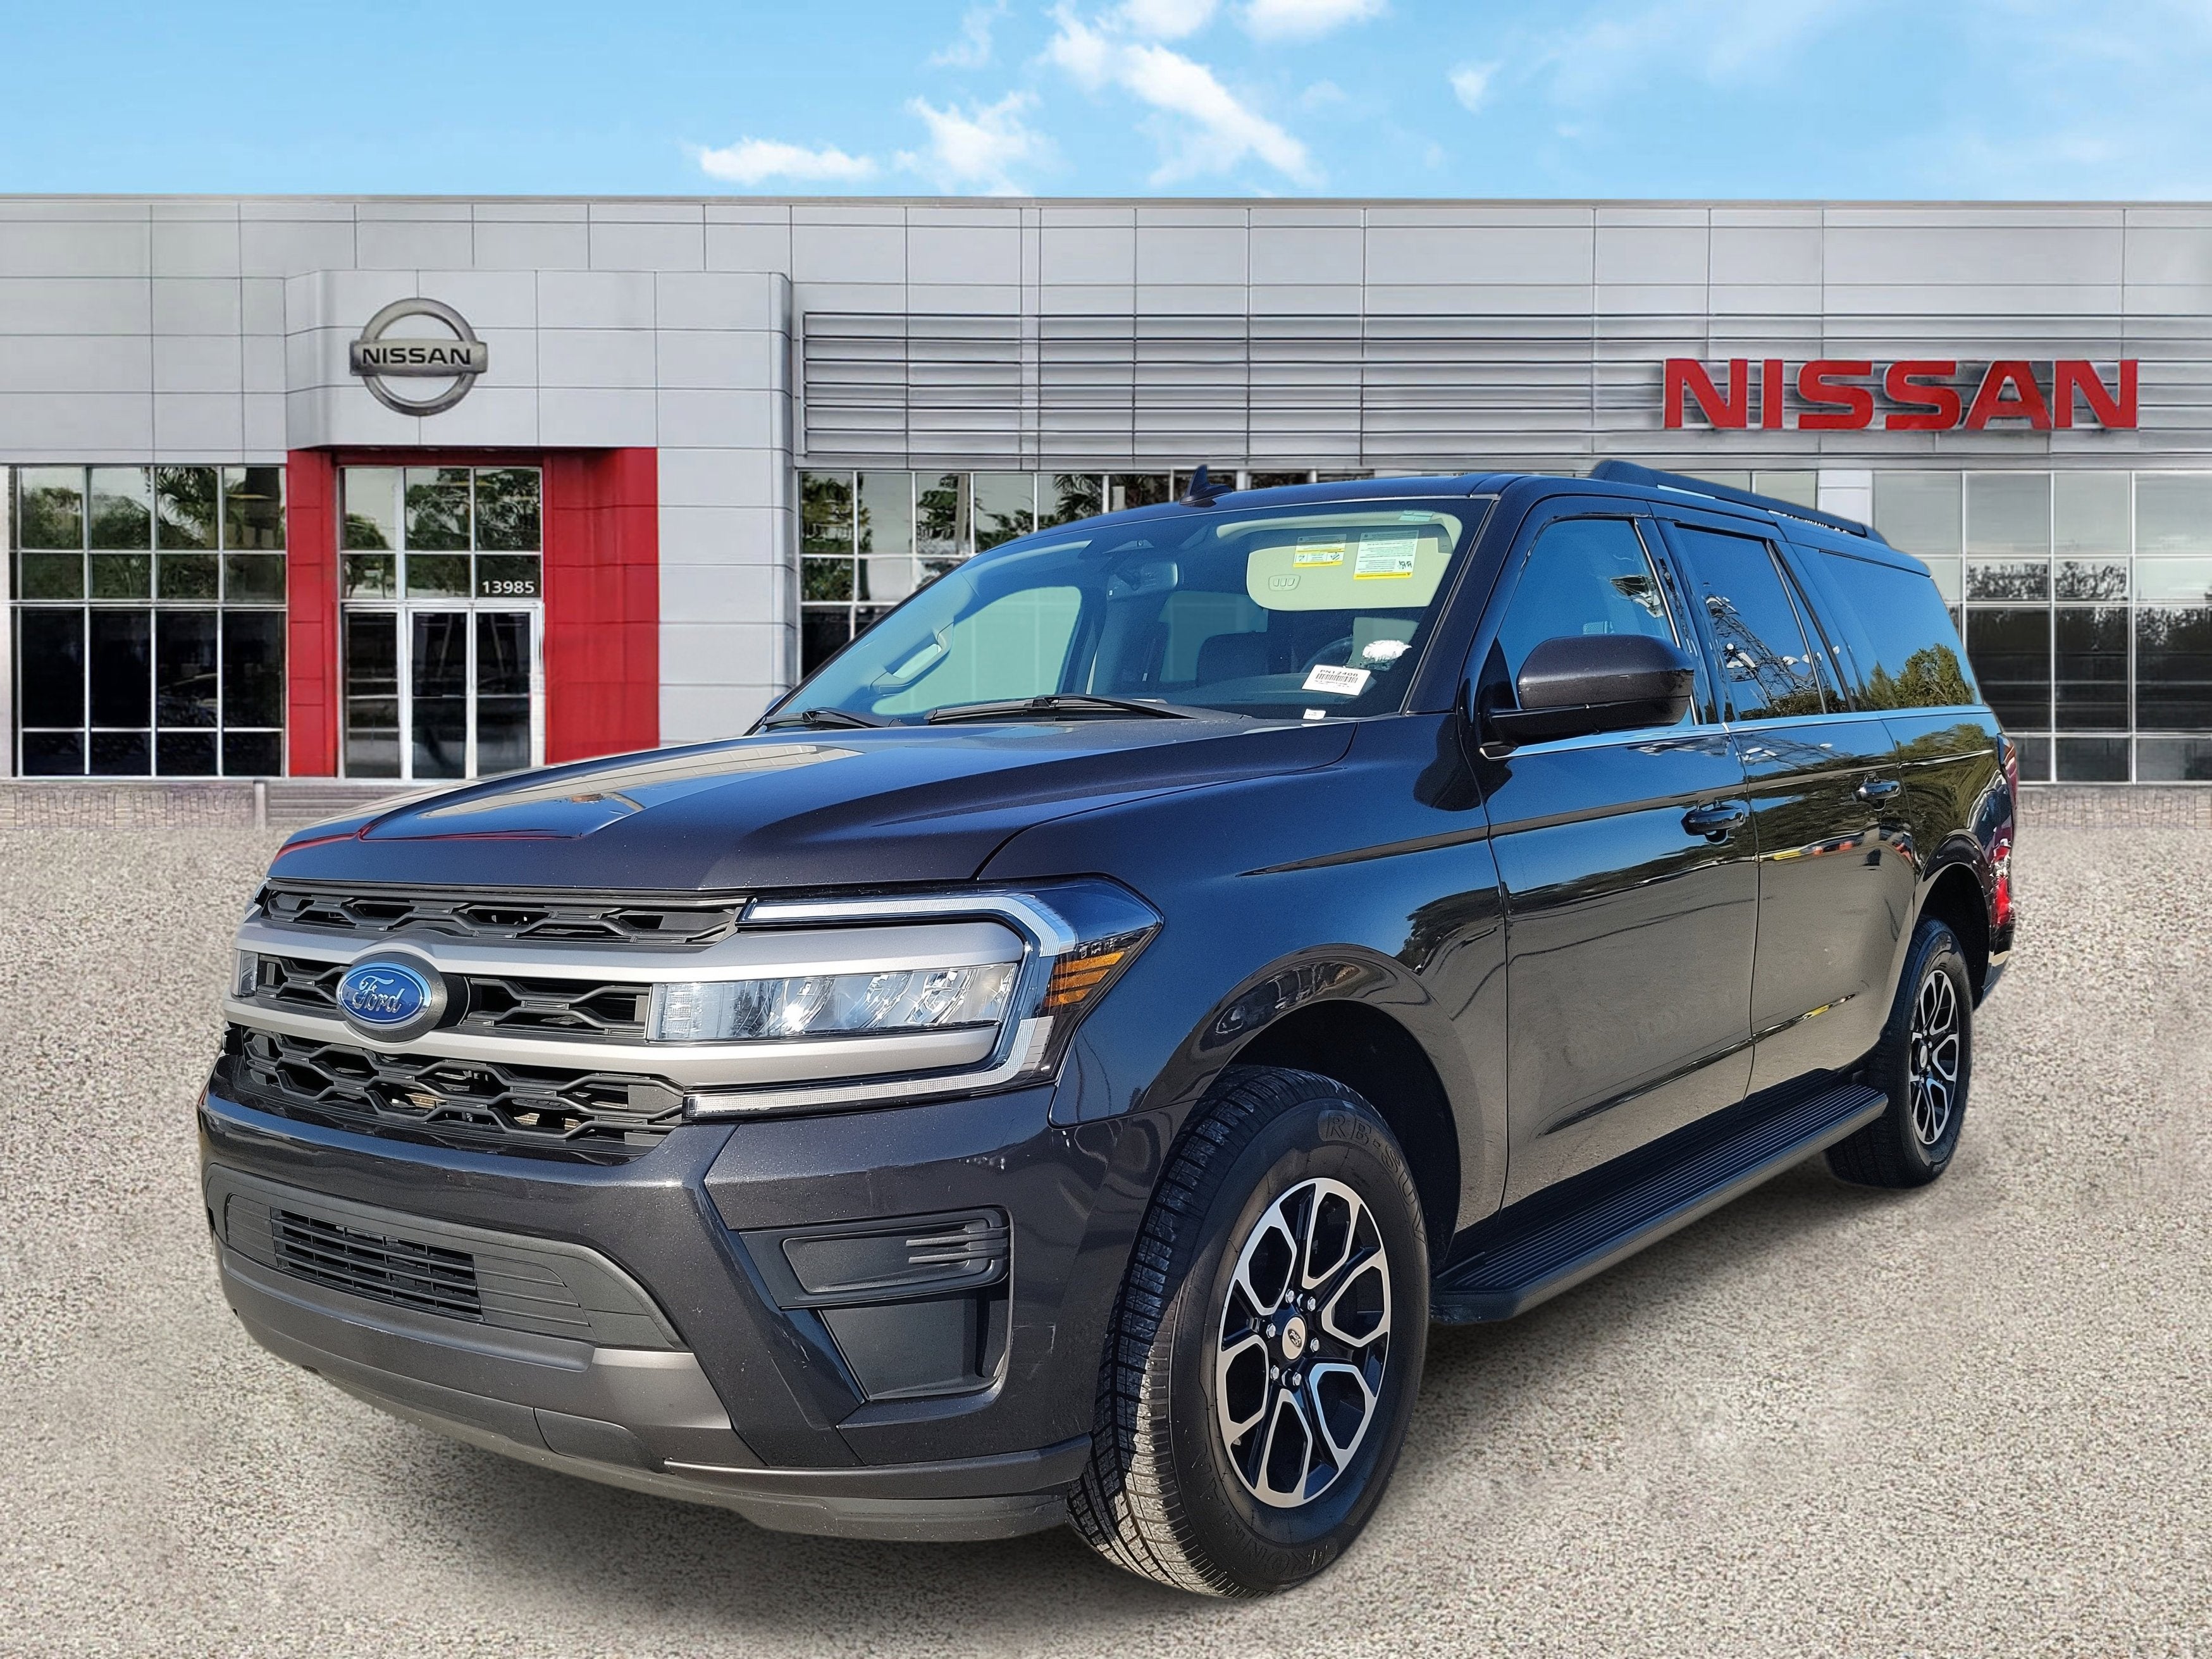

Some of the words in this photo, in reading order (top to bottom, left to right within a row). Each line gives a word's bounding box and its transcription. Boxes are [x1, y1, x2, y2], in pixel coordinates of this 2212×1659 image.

[362, 347, 471, 366] NISSAN
[1664, 359, 2138, 429] NISSAN
[481, 580, 534, 595] 13985
[352, 975, 405, 1013] Ford
